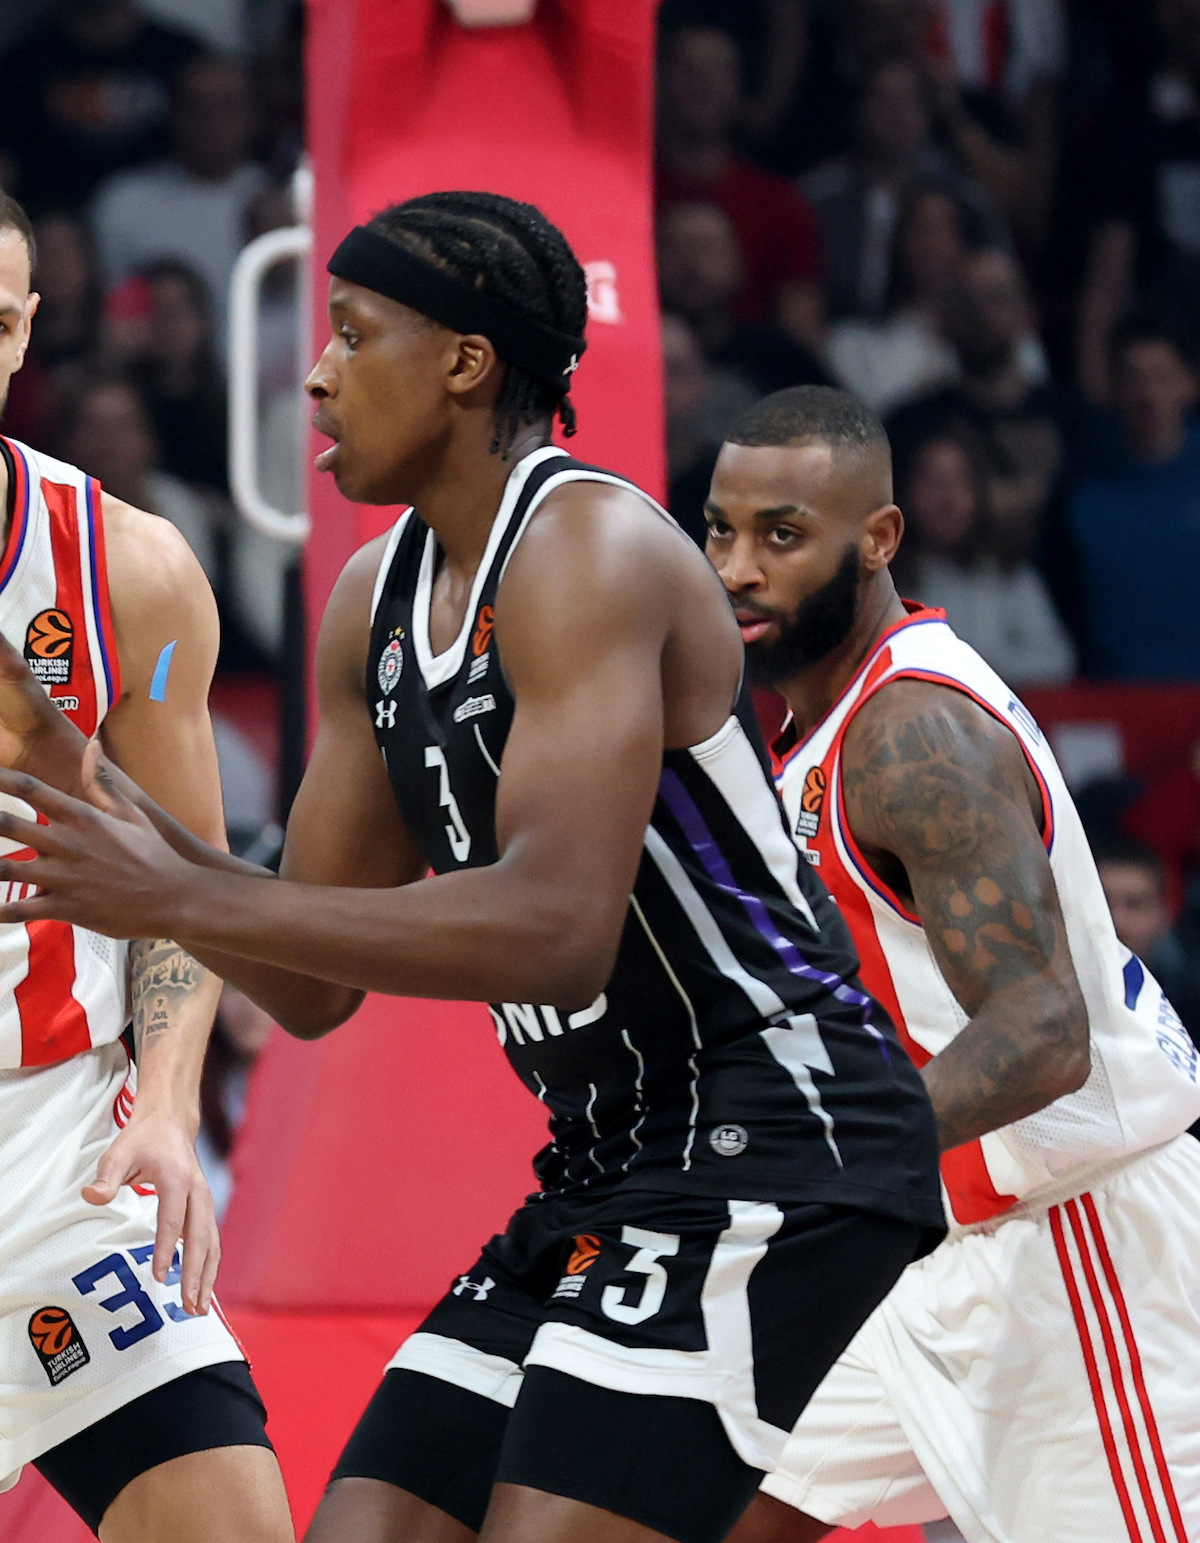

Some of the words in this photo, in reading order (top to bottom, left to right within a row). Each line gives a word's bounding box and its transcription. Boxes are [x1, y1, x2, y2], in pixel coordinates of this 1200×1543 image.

[583, 260, 623, 324] G
[28, 658, 69, 667] TURKISH
[424, 745, 471, 862] 3
[601, 1224, 681, 1325] 3
[47, 1341, 81, 1369] TURKISH
[51, 1349, 84, 1376] AIRLINES
